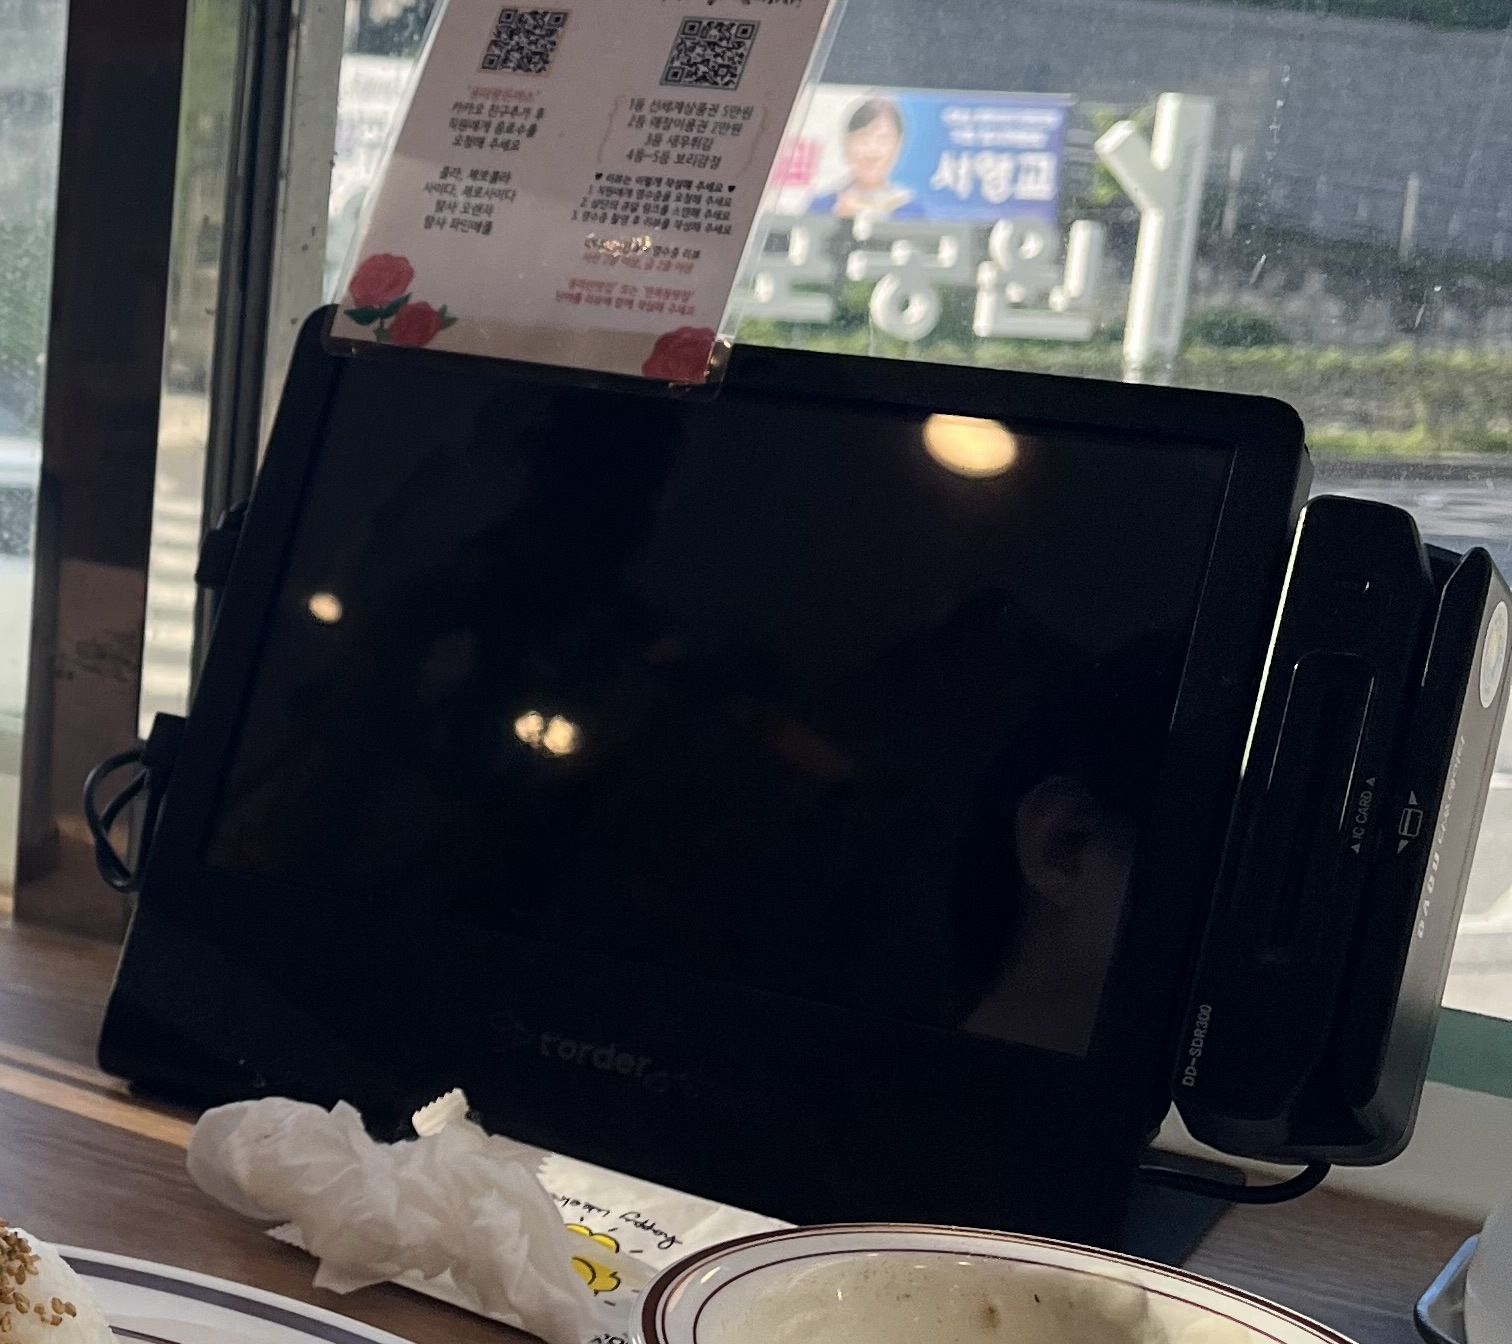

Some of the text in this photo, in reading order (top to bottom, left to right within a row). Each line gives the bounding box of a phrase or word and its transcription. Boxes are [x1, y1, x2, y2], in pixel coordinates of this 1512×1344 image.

[930, 150, 1058, 204] 서영교
[1355, 789, 1373, 823] CARD
[1181, 1004, 1213, 1087] DD-SDR300
